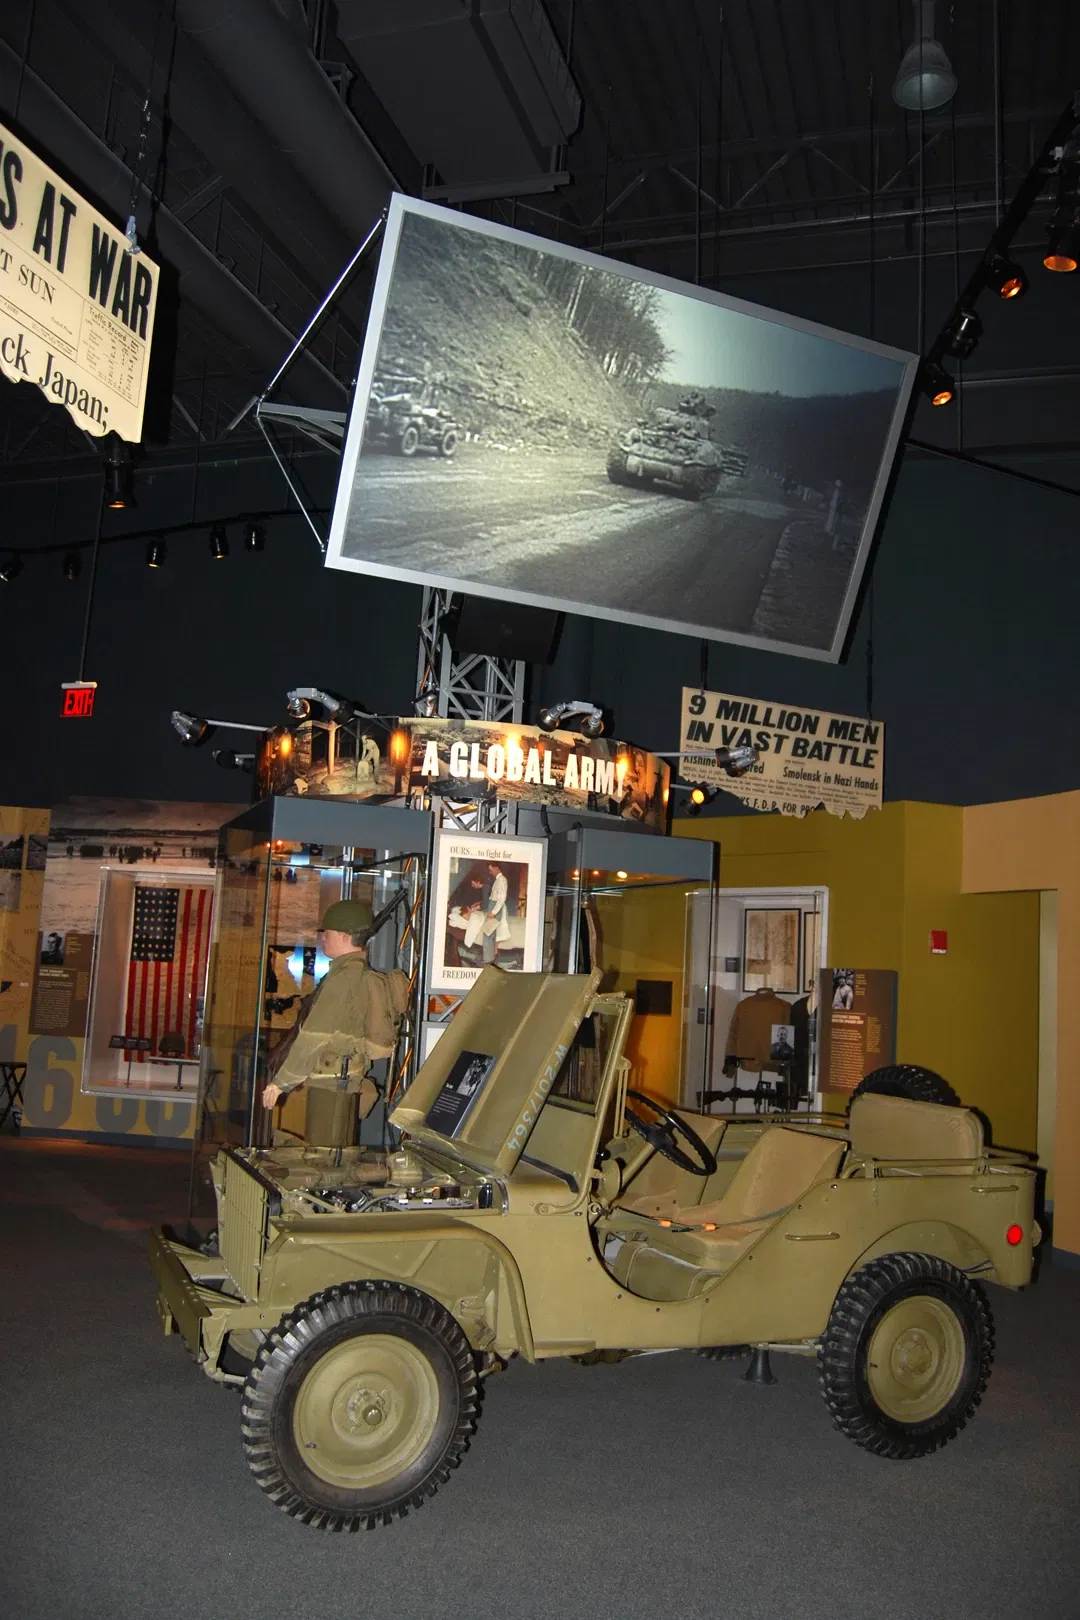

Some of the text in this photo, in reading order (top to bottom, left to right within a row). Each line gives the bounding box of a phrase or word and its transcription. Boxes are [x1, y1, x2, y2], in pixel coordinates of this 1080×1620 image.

[32, 180, 78, 274] AT
[88, 222, 153, 341] WAR
[18, 262, 57, 305] SUN
[38, 351, 110, 434] Japan;
[63, 689, 91, 715] EXIT
[688, 694, 880, 745] 9 MILLION MEN
[686, 719, 715, 743] IN
[721, 724, 790, 755] VAST
[791, 737, 879, 769] BATTLE
[420, 740, 629, 797] A GLOBAL ARMY
[783, 766, 879, 791] Smolensk in Nazi Hands
[782, 802, 797, 814] FOR
[486, 848, 502, 860] fight
[502, 850, 513, 860] for
[442, 970, 477, 980] FREEDOM
